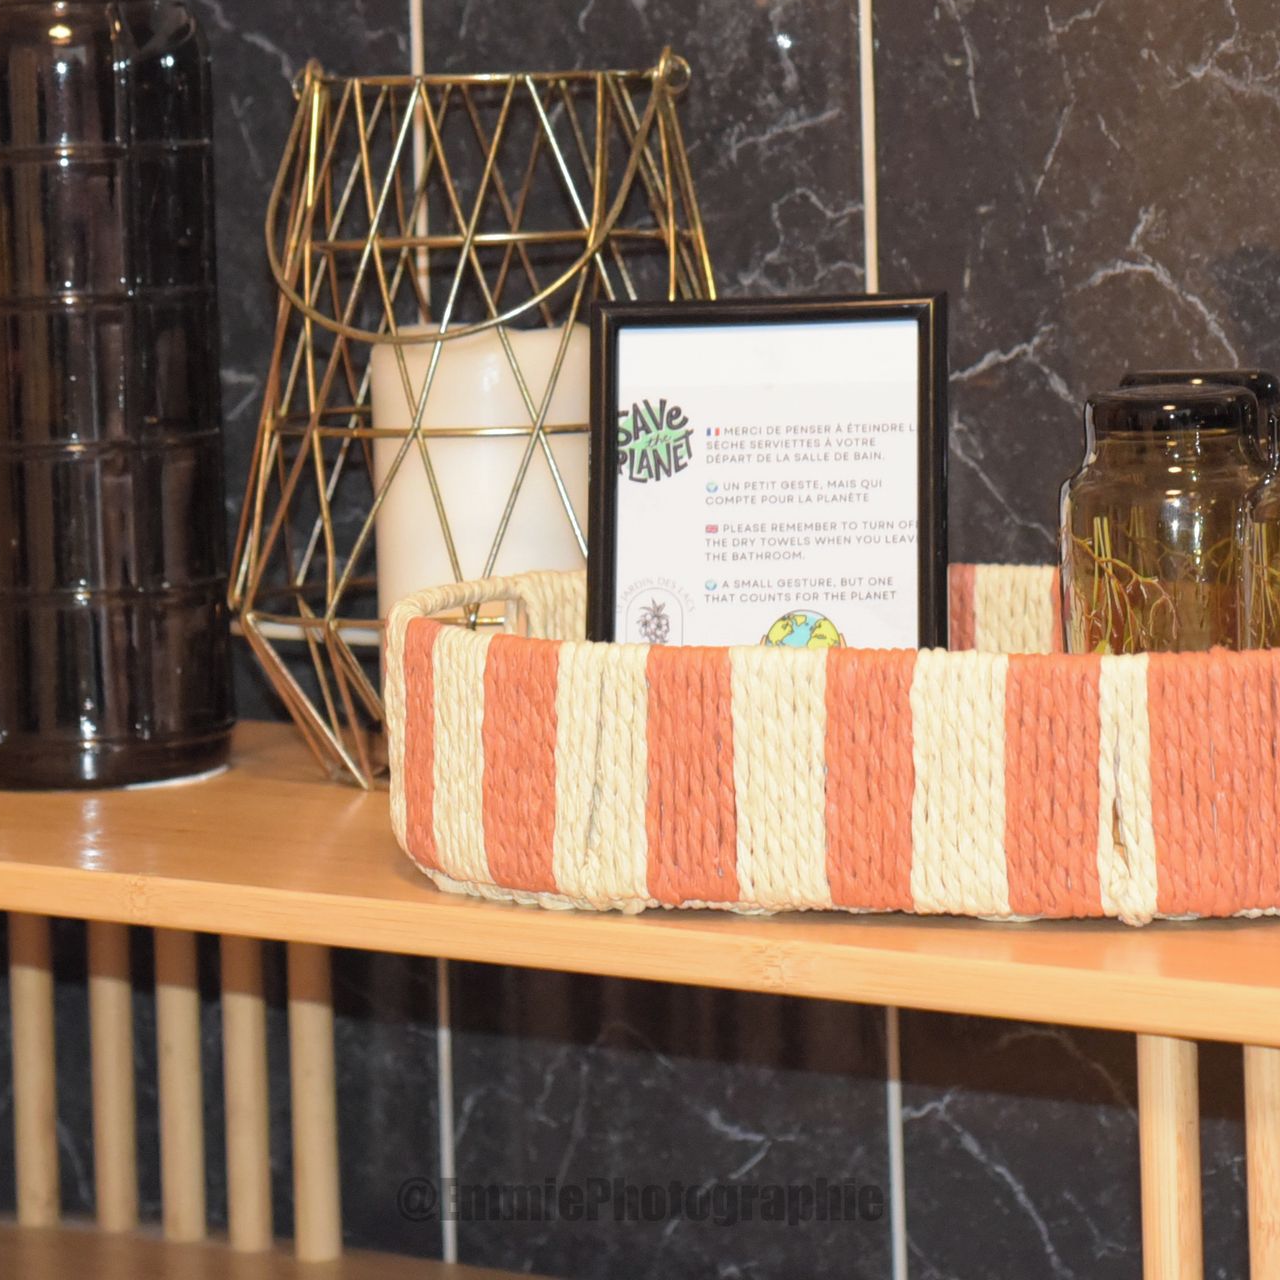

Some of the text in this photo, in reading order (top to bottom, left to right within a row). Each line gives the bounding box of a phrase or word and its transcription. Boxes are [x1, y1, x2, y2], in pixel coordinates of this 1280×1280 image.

[724, 426, 761, 436] MERCI
[767, 426, 780, 435] DE
[786, 425, 831, 434] PENSER
[750, 439, 820, 449] SERVIETTES
[836, 438, 875, 447] VOTRE
[757, 454, 771, 463] DE
[776, 454, 790, 462] LA
[794, 452, 829, 462] SALLE
[834, 452, 848, 461] DE
[723, 482, 739, 491] UN
[744, 481, 776, 490] PETIT
[827, 480, 856, 488] MAIS
[861, 479, 881, 489] QUI
[705, 495, 756, 505] COMPTE
[761, 495, 793, 504] POUR
[799, 495, 812, 503] LA
[723, 523, 766, 533] PLEASE
[771, 522, 837, 532] REMEMBER
[842, 521, 857, 530] TO
[863, 521, 894, 530] TURN
[706, 535, 917, 547] THE DRY TOWELS WHEN YOU LEAV
[706, 552, 726, 561] THE
[734, 580, 772, 588] SMALL
[841, 577, 863, 587] BUT
[868, 577, 893, 586] ONE
[704, 591, 896, 603] THAT COUNTS FOR THE PLANET
